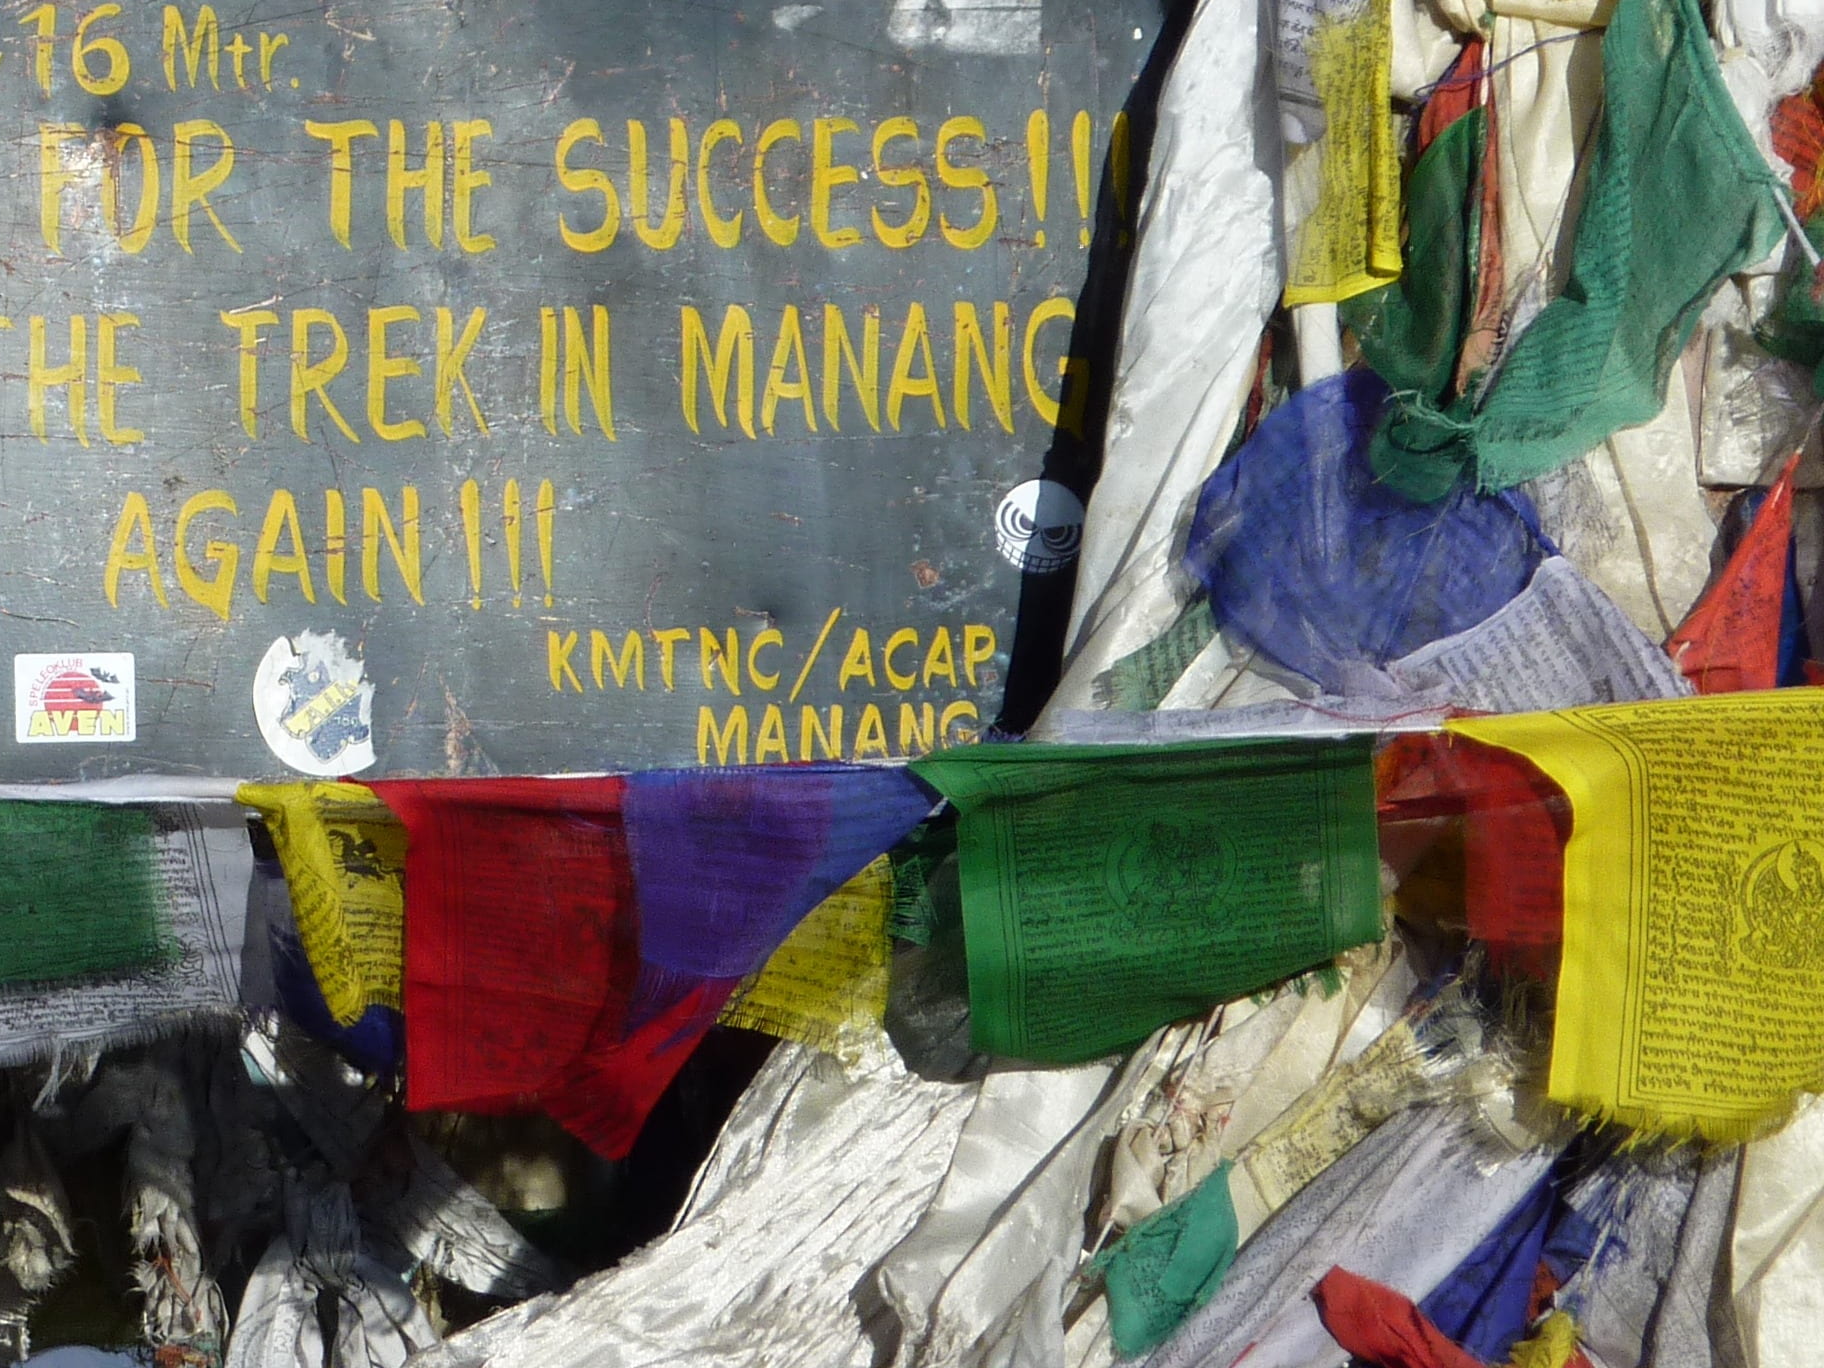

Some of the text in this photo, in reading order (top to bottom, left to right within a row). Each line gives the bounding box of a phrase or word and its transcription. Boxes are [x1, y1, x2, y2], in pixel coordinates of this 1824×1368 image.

[163, 3, 300, 95] Mtr.
[39, 121, 243, 255] FOR
[306, 118, 497, 254] THE
[221, 306, 489, 443] TREK
[540, 304, 617, 440] IN
[681, 297, 1088, 441] MANANG
[547, 606, 997, 704] KMTNC/ACAP
[27, 709, 125, 737] AVEN
[697, 702, 980, 766] MANANG
